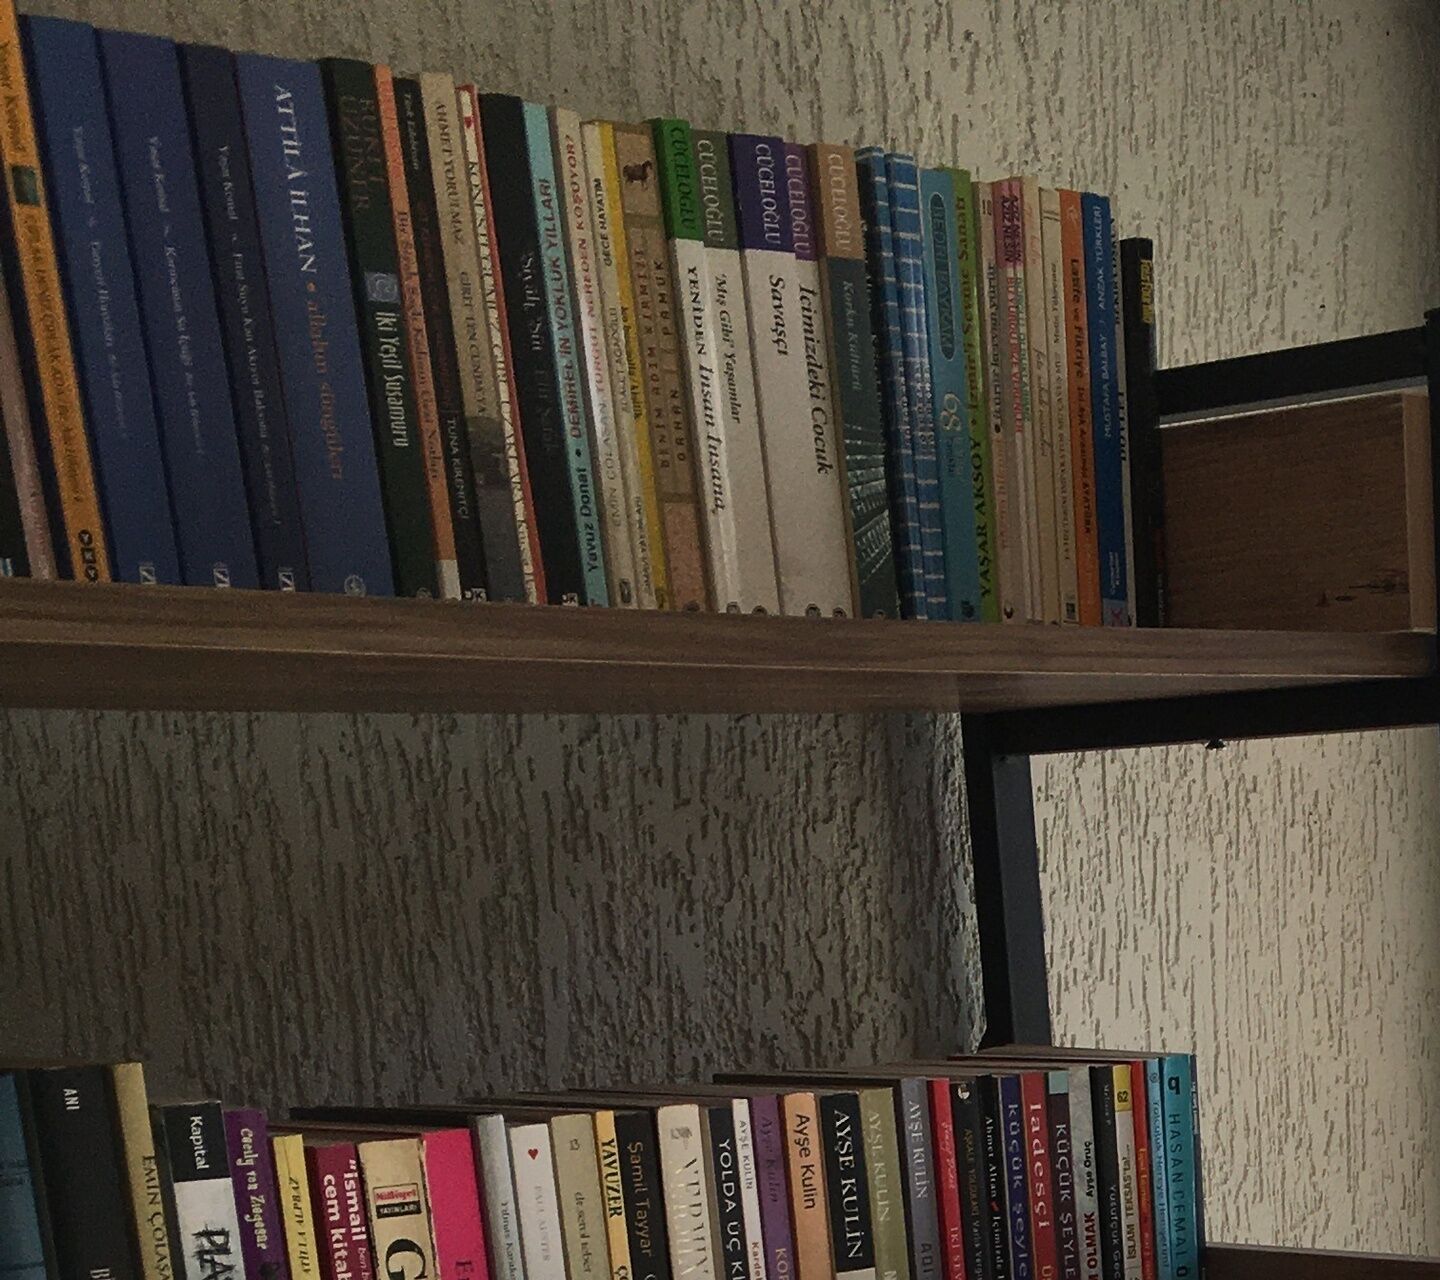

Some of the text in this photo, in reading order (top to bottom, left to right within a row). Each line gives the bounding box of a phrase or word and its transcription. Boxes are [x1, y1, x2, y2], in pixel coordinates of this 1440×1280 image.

[286, 188, 318, 274] İLHAN
[652, 259, 673, 336] PAMUK
[686, 266, 708, 356] YENİDEN
[698, 365, 720, 429] İnsan
[381, 375, 411, 448] Susamuru
[722, 352, 744, 424] Yaşamlar
[968, 436, 988, 516] AKSOY
[974, 523, 993, 597] YAŞAR
[62, 1088, 81, 1111] ANI
[719, 1138, 736, 1211] YOLDA
[793, 1113, 819, 1210] Ayşe Kulin
[832, 1109, 856, 1170] AYŞE
[1053, 1124, 1074, 1202] KÜÇÜK
[1167, 1113, 1186, 1184] HASAN
[601, 1138, 623, 1218] YAVUZER
[633, 1198, 654, 1257] Tayyar
[840, 1176, 864, 1259] KULİN
[1083, 1211, 1098, 1269] OLMAK
[1169, 1188, 1189, 1259] CEMAL
